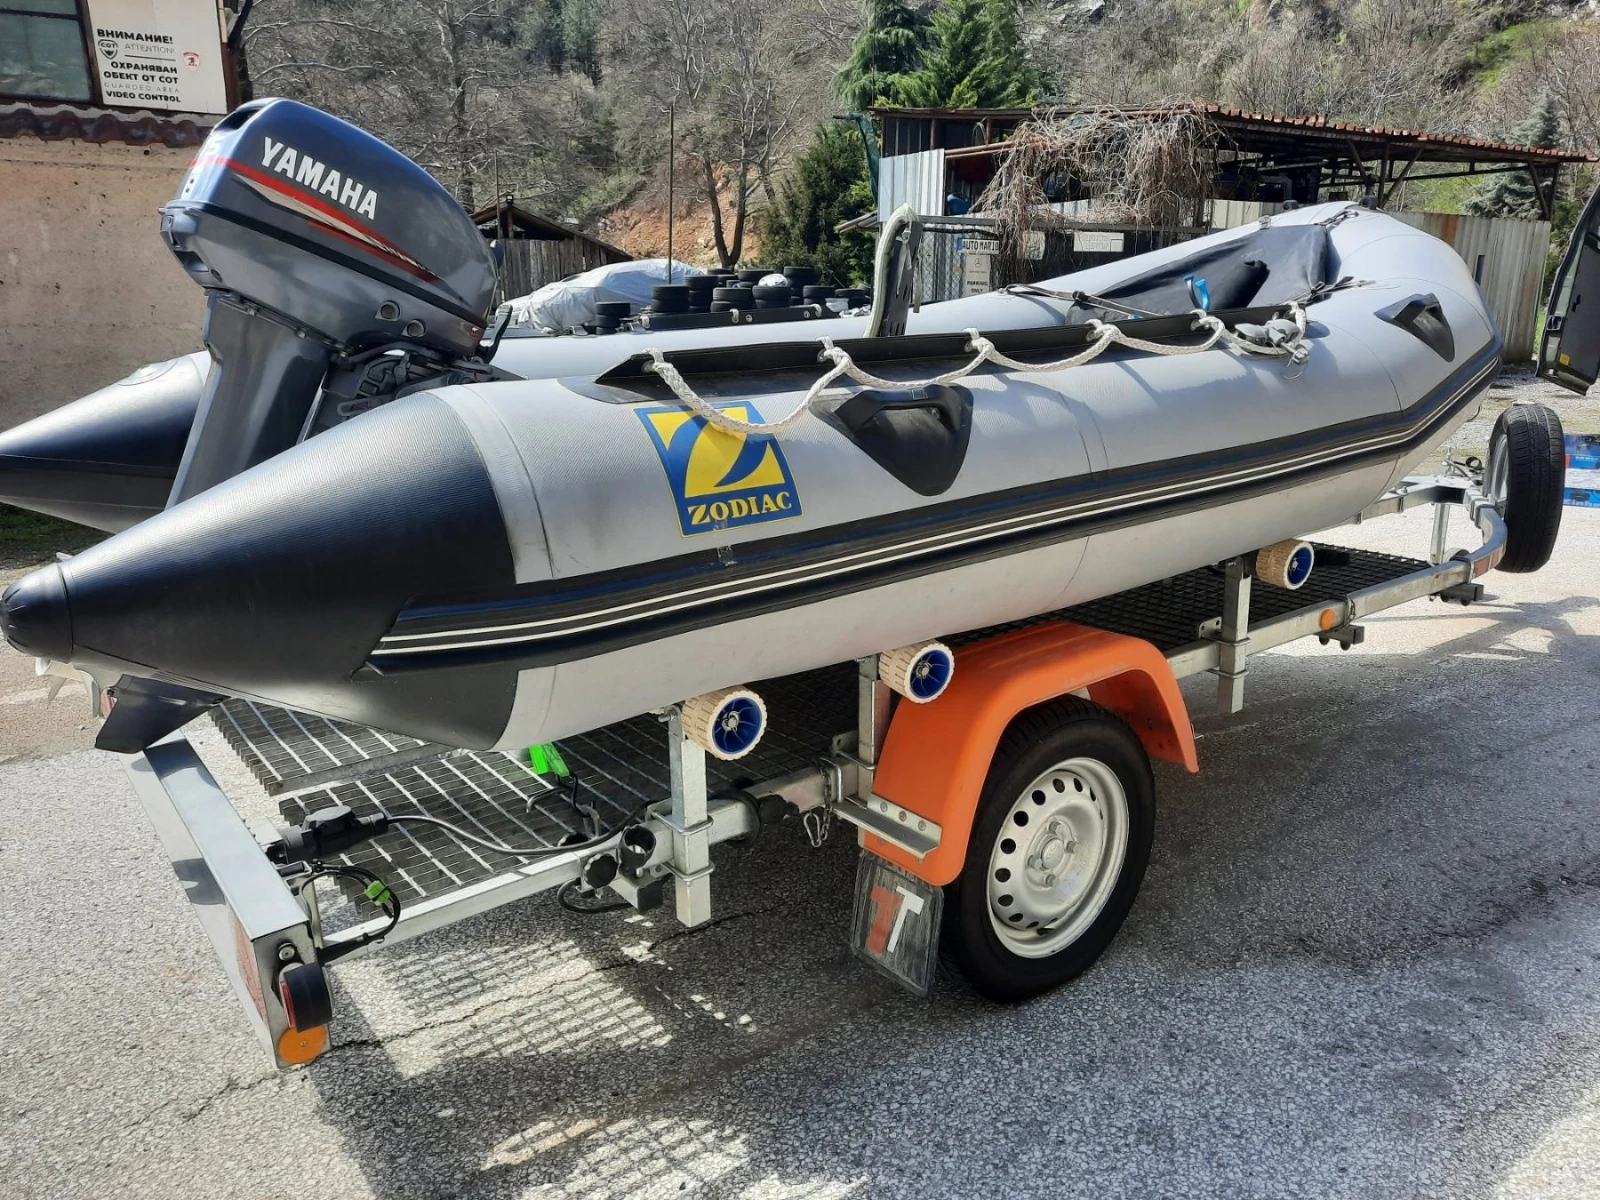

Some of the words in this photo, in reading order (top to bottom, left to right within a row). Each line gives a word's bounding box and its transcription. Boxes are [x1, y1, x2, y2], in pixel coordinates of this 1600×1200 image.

[97, 28, 174, 44] ВНИМАНИЕ!
[110, 61, 178, 74] ОХРАНЯВАН
[103, 71, 139, 80] ОБЕКТ
[142, 74, 156, 83] ОТ
[159, 75, 179, 84] СОТ
[104, 81, 152, 92] GUARDED
[105, 90, 136, 99] VIDEO
[138, 93, 181, 103] CONTROL
[261, 136, 378, 220] YAMAHA
[962, 240, 979, 250] AUTO
[687, 491, 792, 526] ZODIAC
